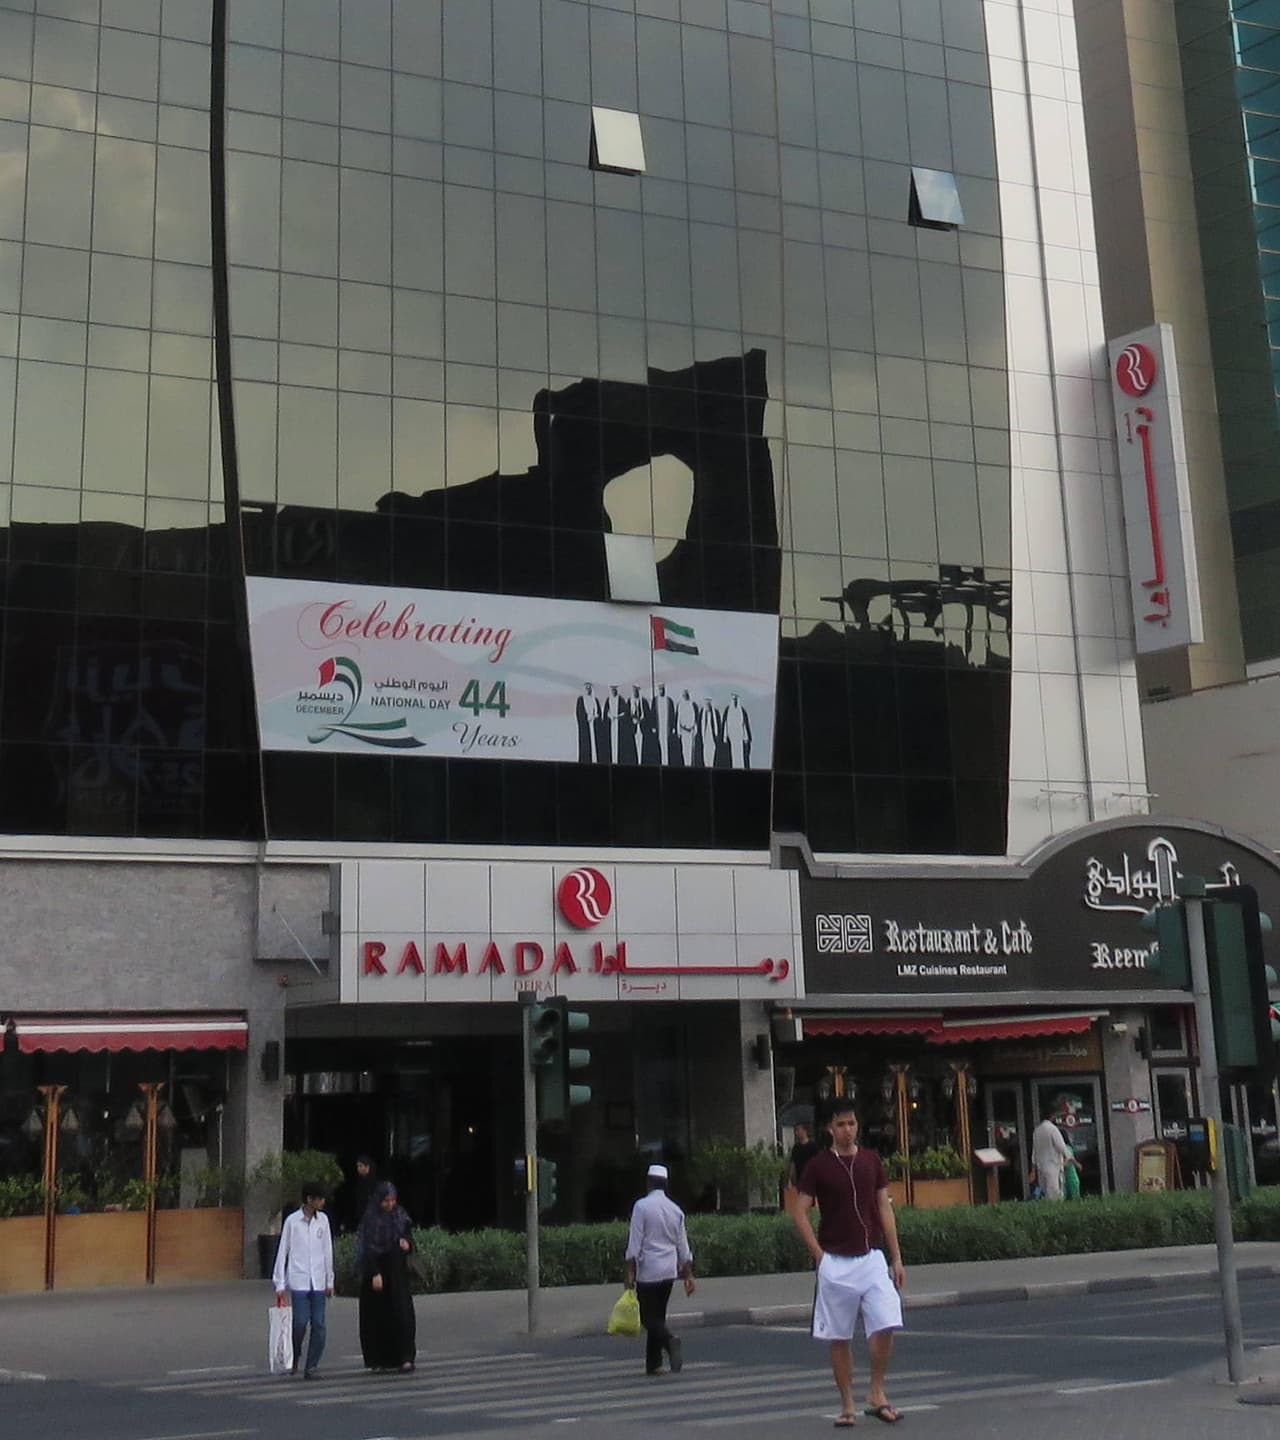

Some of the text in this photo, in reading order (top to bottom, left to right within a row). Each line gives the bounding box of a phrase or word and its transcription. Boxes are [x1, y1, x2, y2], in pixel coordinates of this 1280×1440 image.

[297, 598, 512, 663] Celebrating
[296, 704, 345, 716] DECEMBER
[371, 696, 451, 710] NATIONAL DAY
[458, 679, 510, 718] 44
[452, 721, 521, 753] Years
[885, 920, 981, 954] Restaurant
[984, 930, 999, 955] &
[363, 941, 577, 976] RAMADA
[897, 964, 1007, 976] LMZ Cuisines Restaurant
[514, 980, 553, 992] DEIRA
